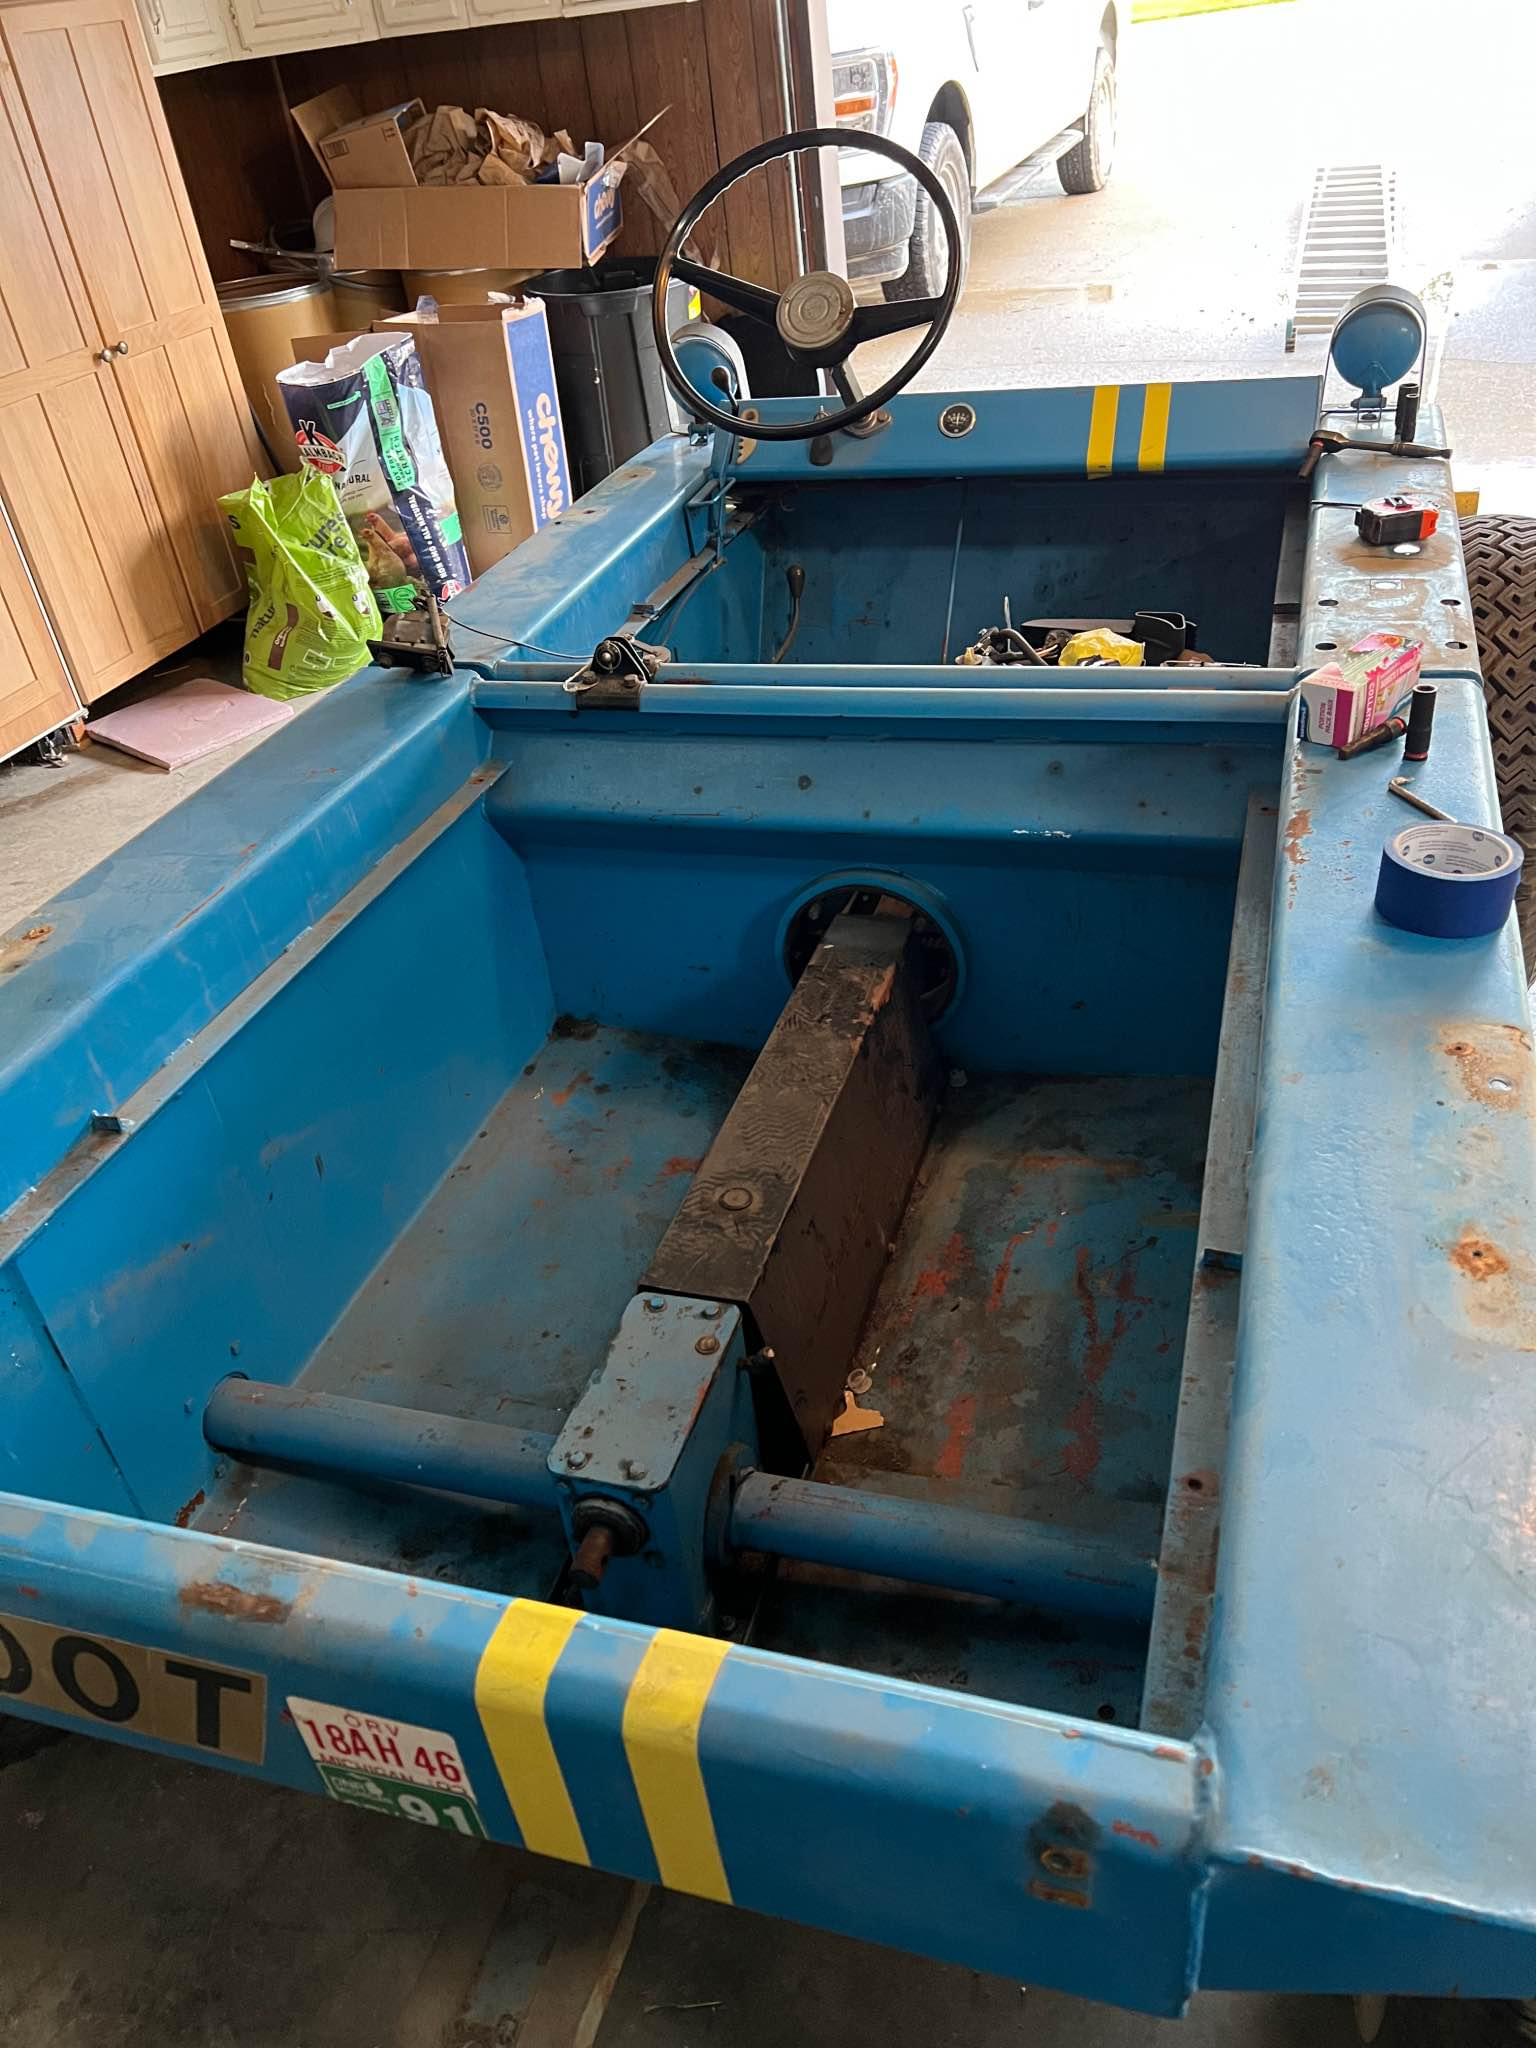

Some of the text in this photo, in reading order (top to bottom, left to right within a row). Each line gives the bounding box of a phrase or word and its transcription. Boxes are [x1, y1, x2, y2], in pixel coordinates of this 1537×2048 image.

[475, 403, 493, 449] C500
[536, 393, 563, 519] chewy
[408, 494, 426, 527] NATURAL
[421, 526, 433, 540] ALL
[428, 545, 441, 562] GMO
[435, 562, 447, 579] NON
[344, 1713, 398, 1737] ORV
[303, 1719, 462, 1784] 18AH 46
[397, 1794, 474, 1837] 91
